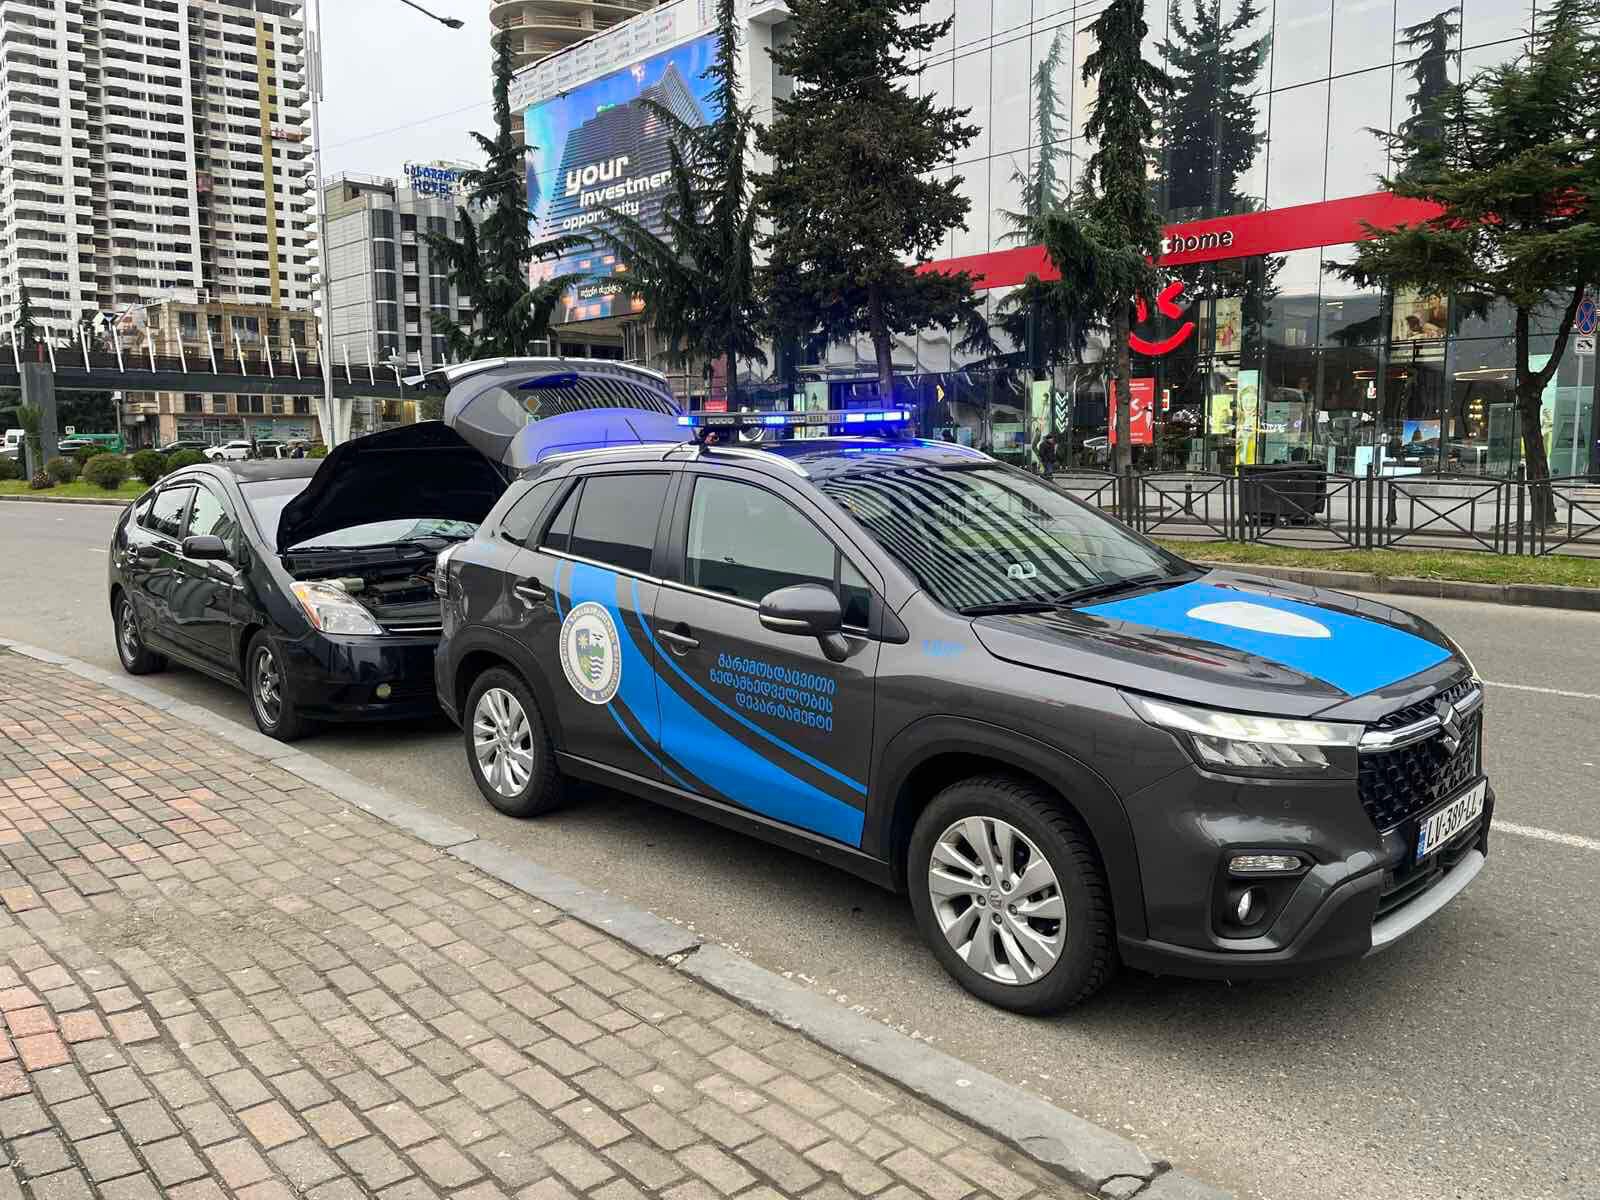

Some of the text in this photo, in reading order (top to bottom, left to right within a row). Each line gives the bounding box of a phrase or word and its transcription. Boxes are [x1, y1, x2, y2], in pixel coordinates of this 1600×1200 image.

[411, 178, 453, 194] HOTEL
[565, 156, 629, 197] your
[580, 169, 672, 208] investmen
[562, 200, 640, 231] oppornity
[735, 692, 833, 732] დეპარტამენტი
